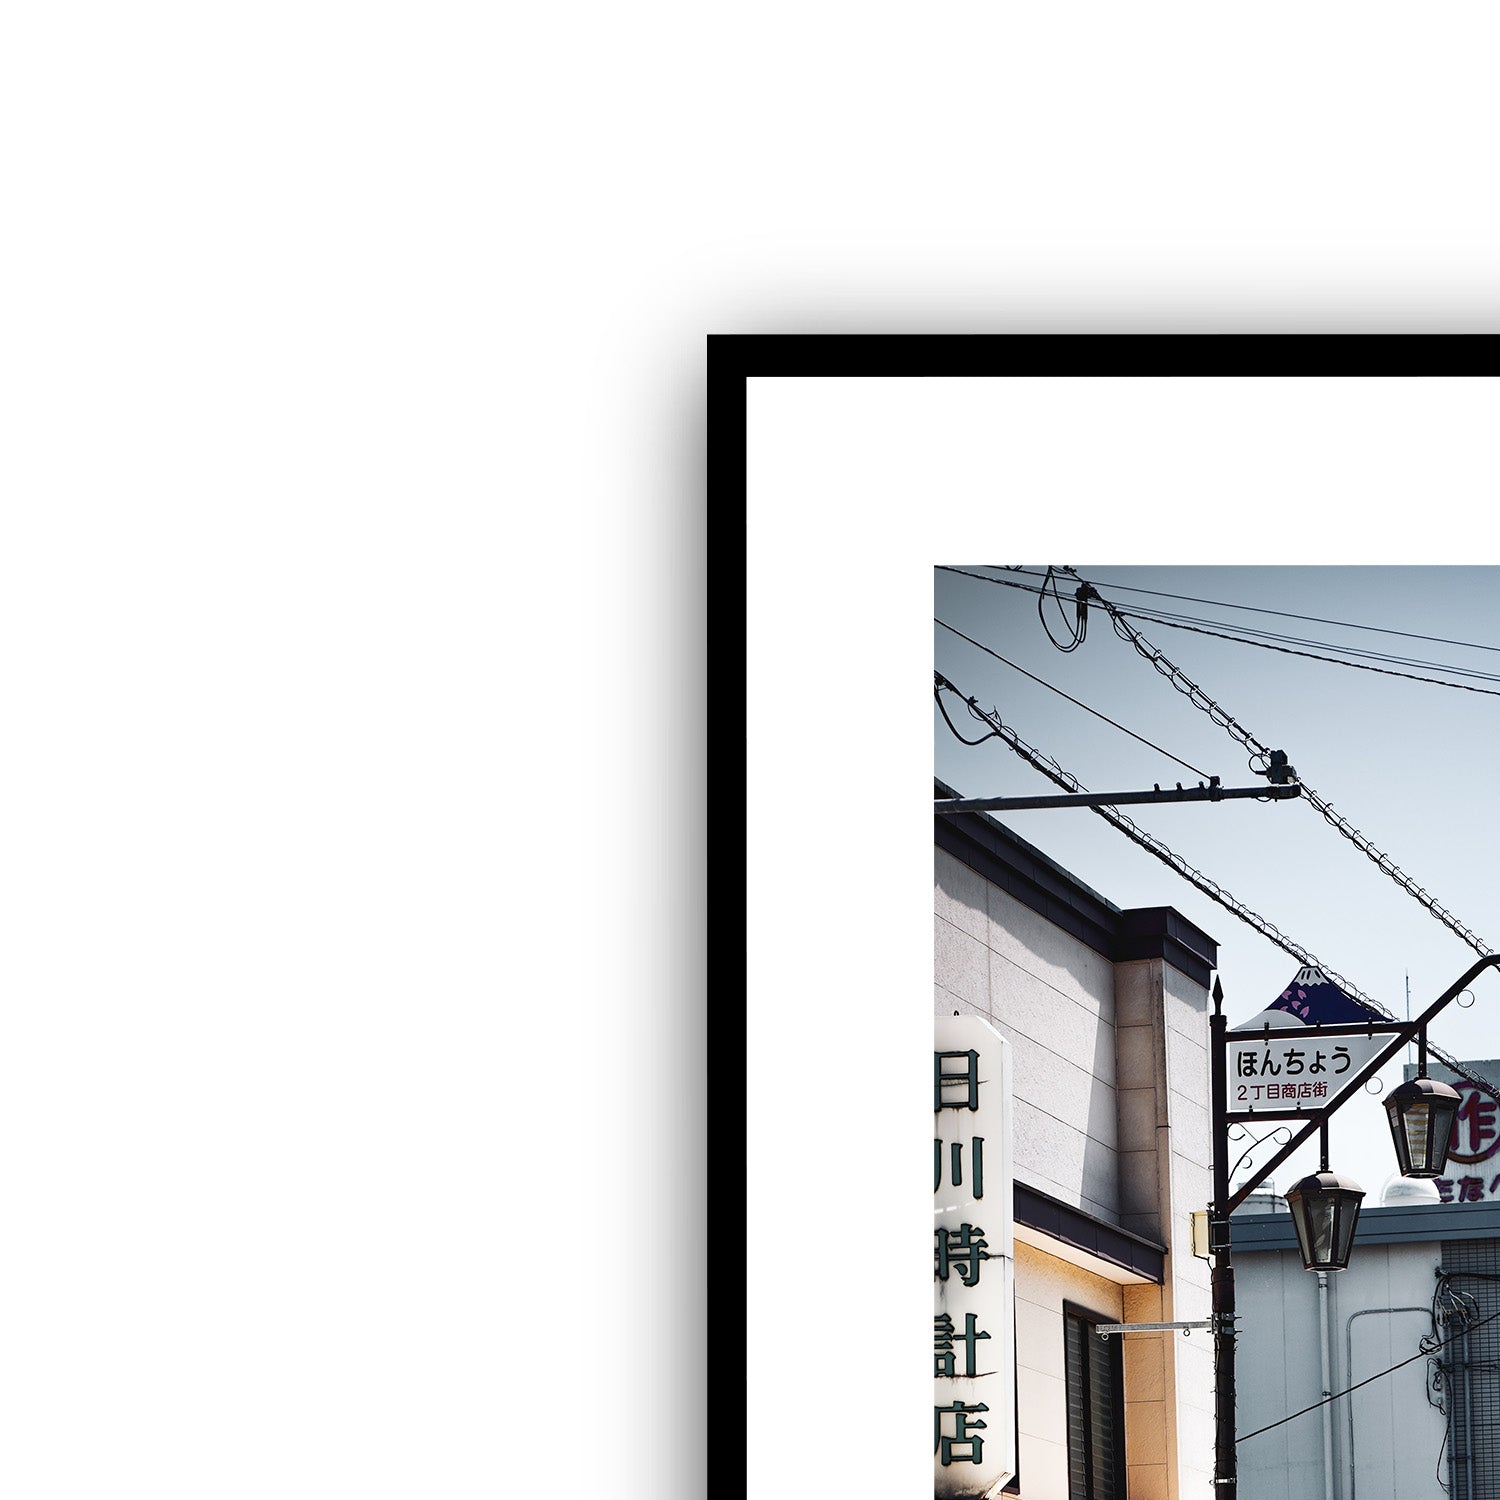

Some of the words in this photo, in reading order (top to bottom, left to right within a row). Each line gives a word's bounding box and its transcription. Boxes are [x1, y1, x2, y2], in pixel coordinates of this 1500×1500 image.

[1237, 1045, 1351, 1078] ほんちょう
[1237, 1081, 1328, 1101] 2丁目商店街
